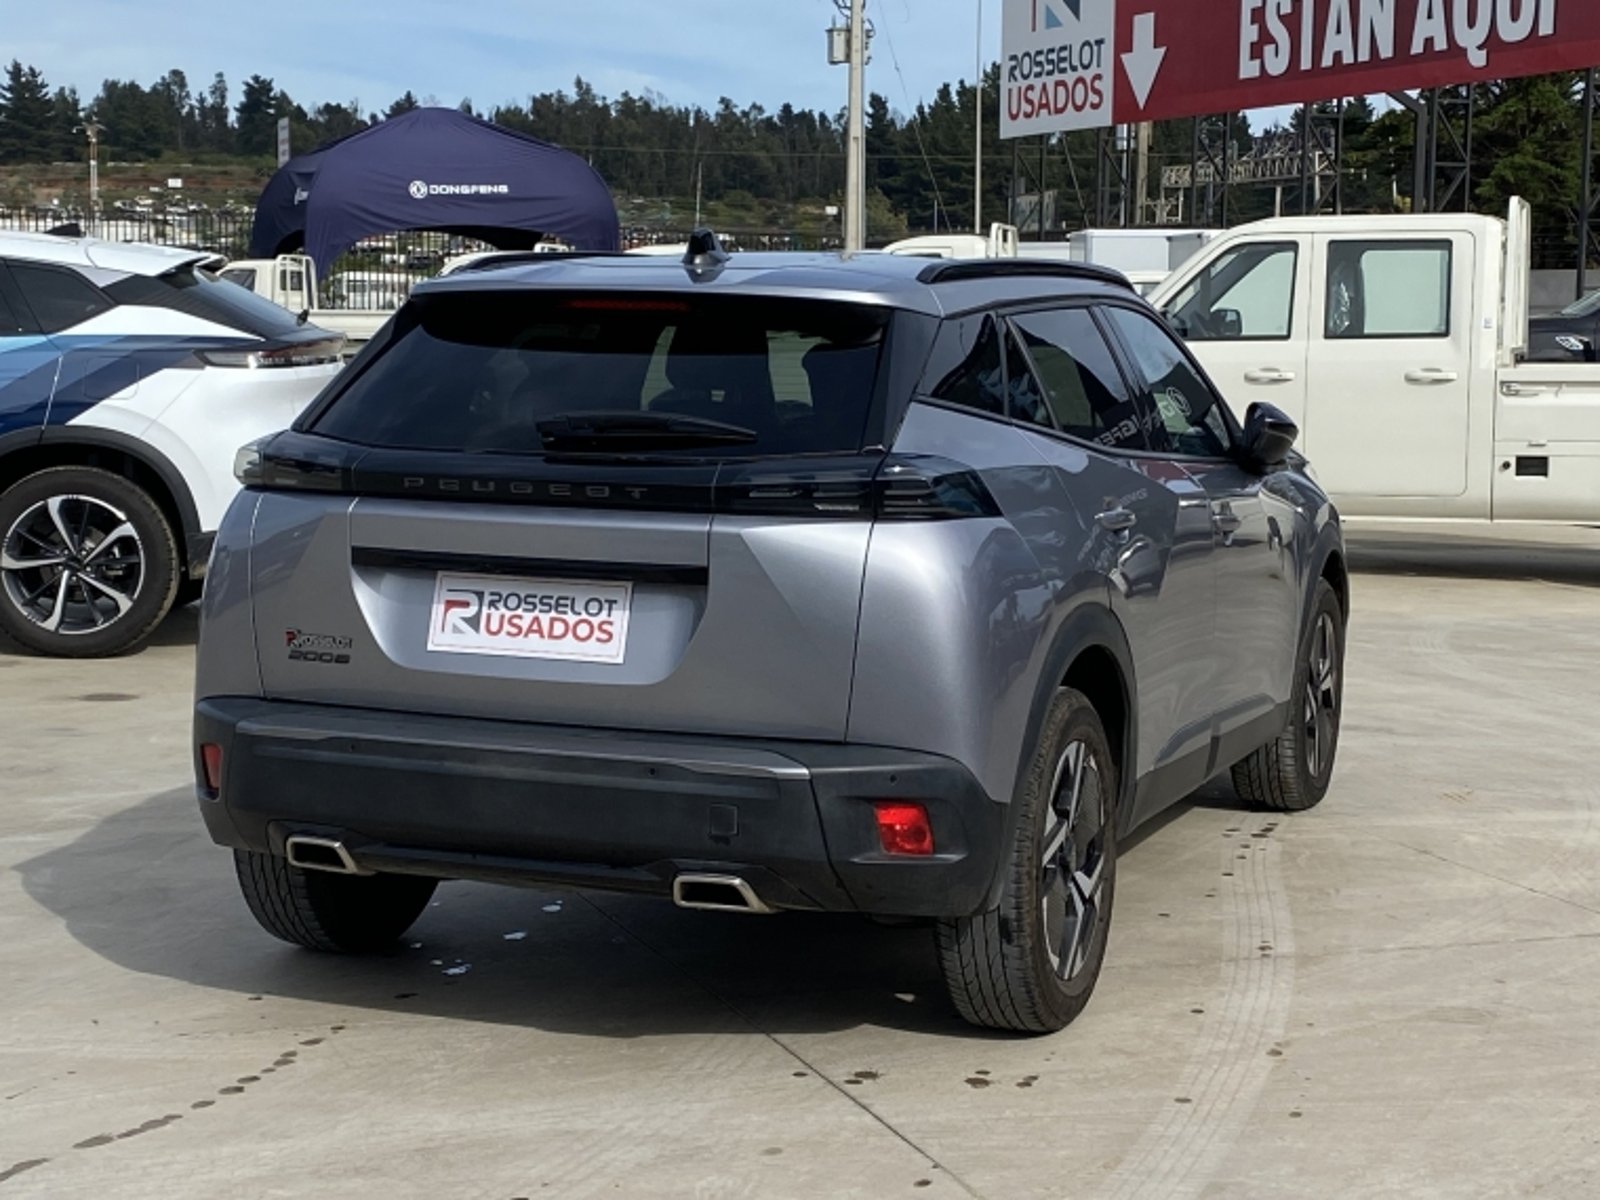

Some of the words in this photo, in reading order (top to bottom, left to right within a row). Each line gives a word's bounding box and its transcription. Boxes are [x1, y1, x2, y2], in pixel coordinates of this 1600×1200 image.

[1008, 37, 1105, 83] ROSSELOT
[1008, 73, 1104, 121] USADOS
[429, 184, 508, 195] DONGFENG
[403, 477, 648, 499] PEUGEOT
[487, 591, 618, 617] ROSSELOT
[484, 613, 614, 644] USADOS
